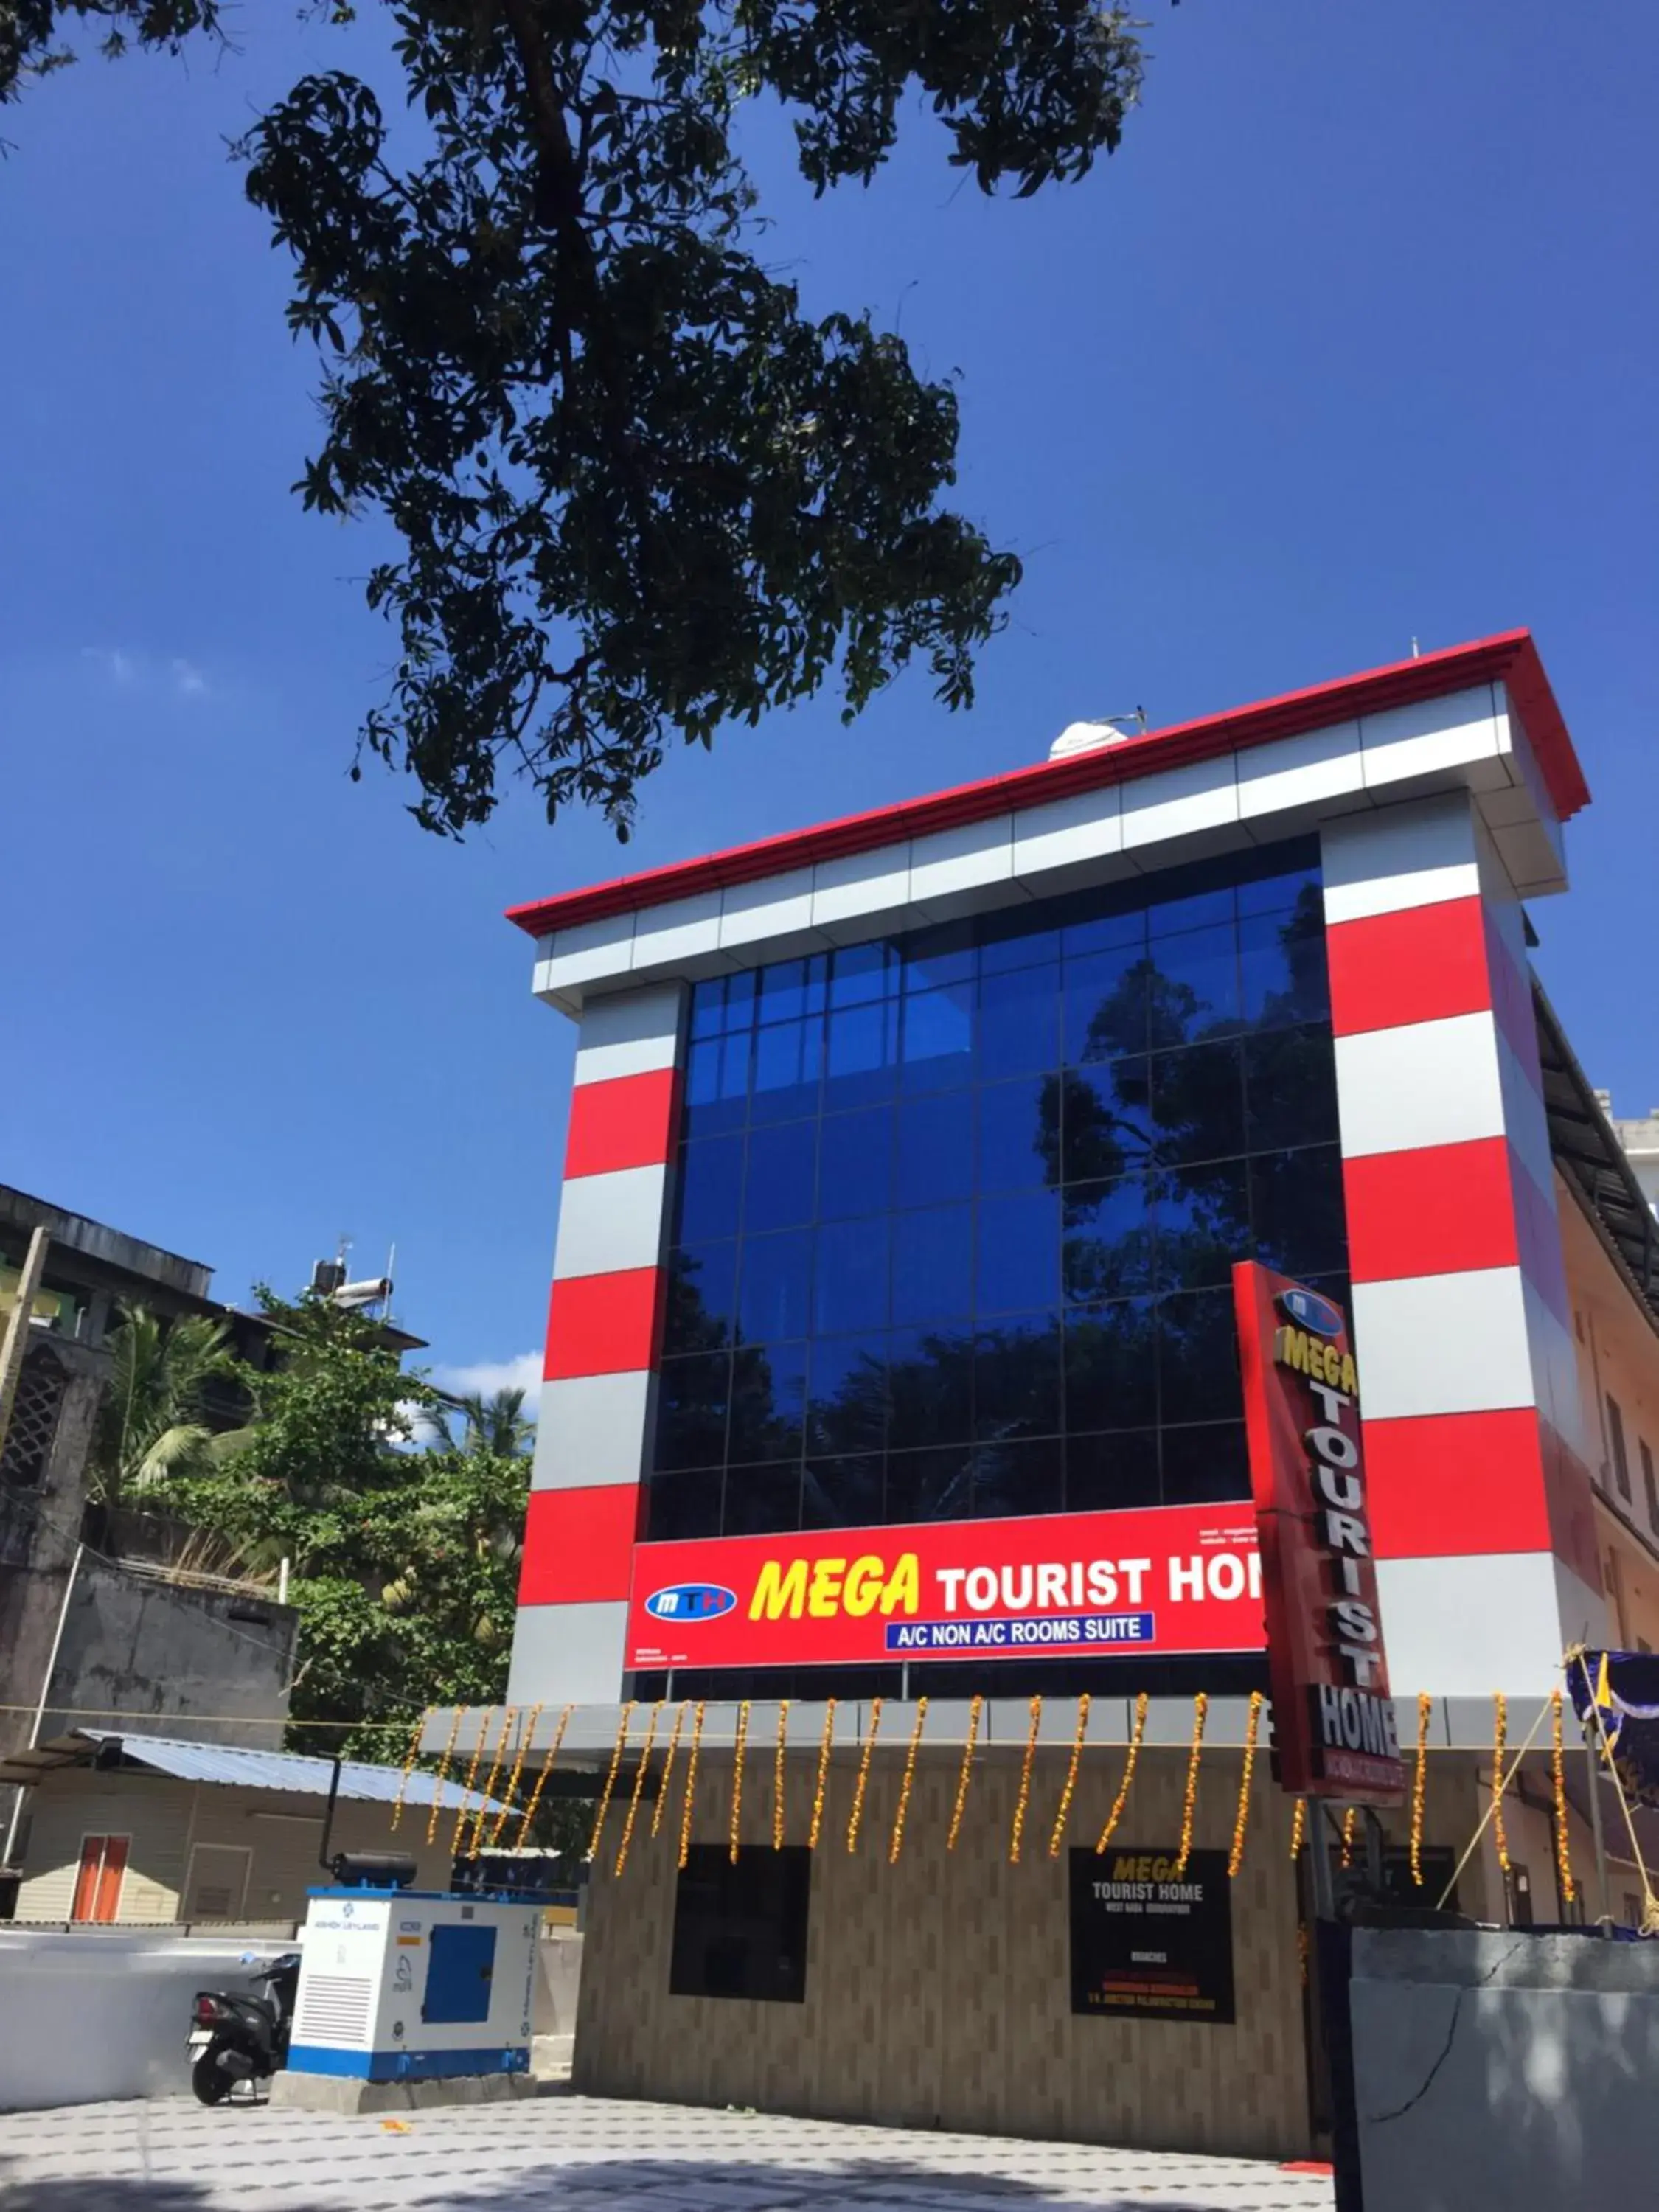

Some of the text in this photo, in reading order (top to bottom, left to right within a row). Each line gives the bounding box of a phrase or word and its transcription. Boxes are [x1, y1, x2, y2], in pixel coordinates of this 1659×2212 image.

[1282, 1325, 1358, 1397] MEGA
[1309, 1380, 1381, 1688] TOURIST
[748, 1553, 919, 1621] MEGA
[936, 1558, 1151, 1613] TOURIST
[897, 1617, 1141, 1646] A/C NON A/C ROOMS SUITE
[1319, 1683, 1401, 1759] HOME
[1092, 1882, 1203, 1902] TOURIST HOME
[1113, 1856, 1184, 1882] MEGA
